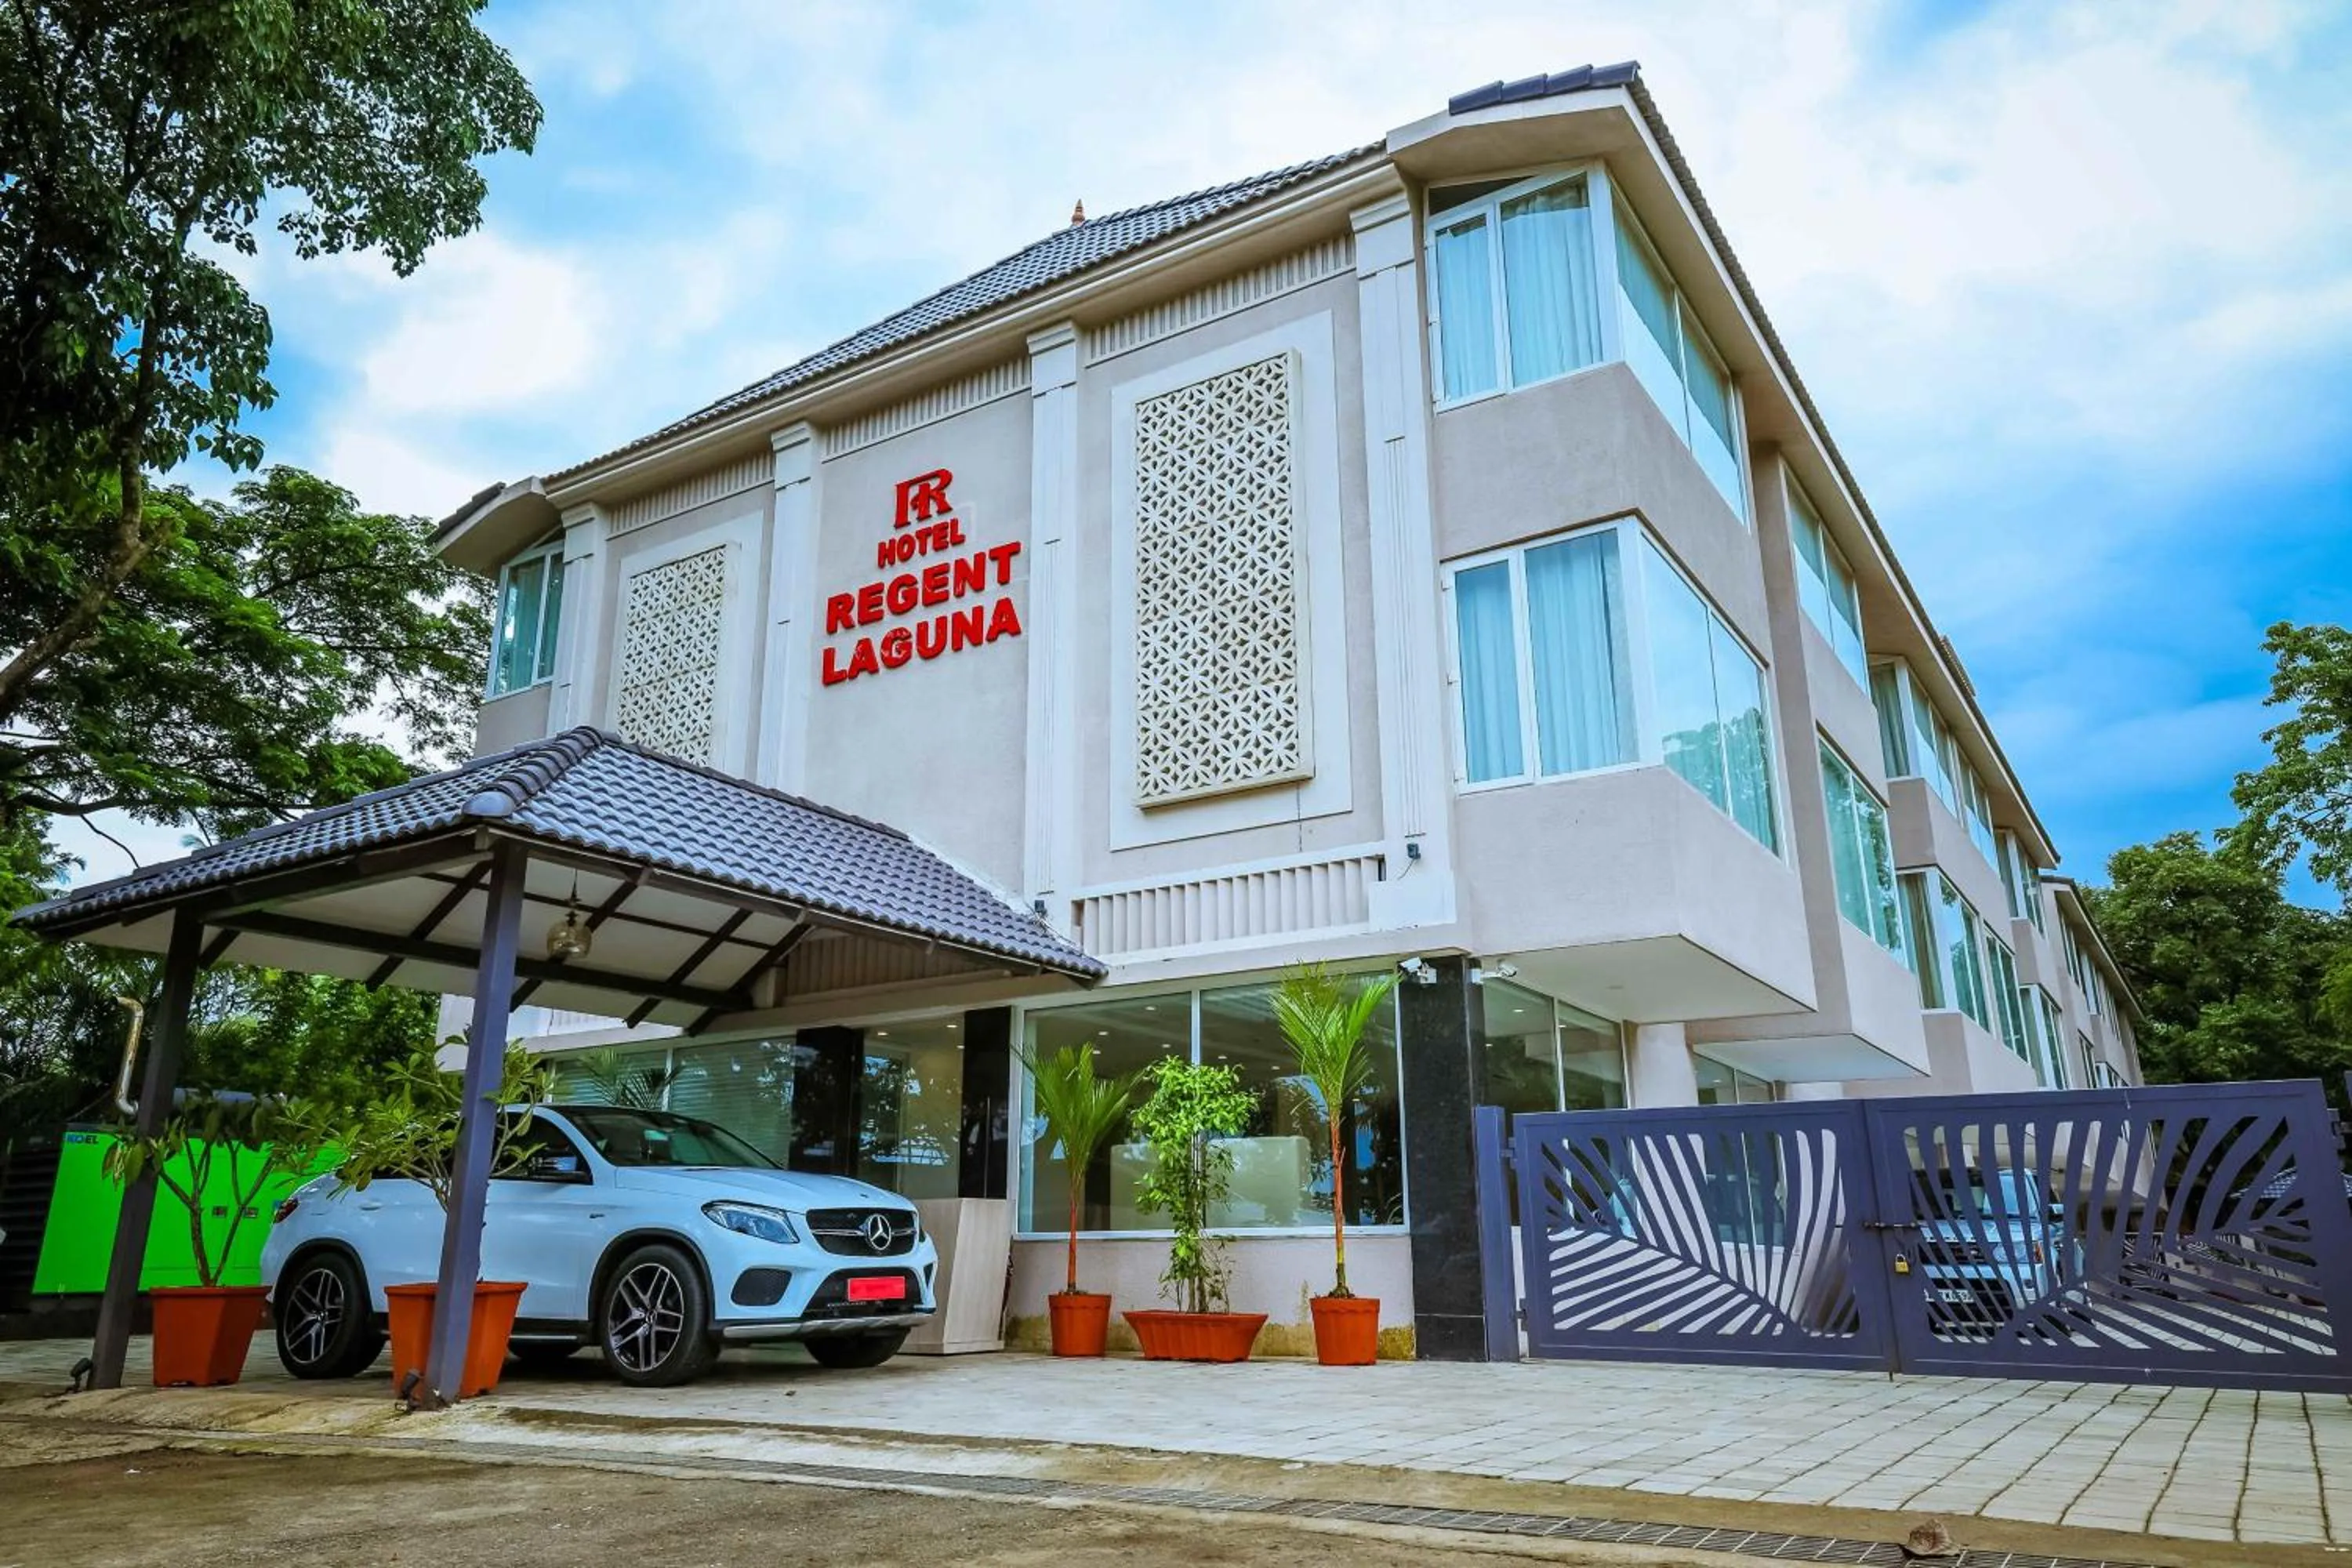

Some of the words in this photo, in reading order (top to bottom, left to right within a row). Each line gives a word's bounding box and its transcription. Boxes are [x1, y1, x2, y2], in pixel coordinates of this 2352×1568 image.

[826, 541, 1022, 633] REGENT
[877, 518, 966, 568] HOTEL
[822, 597, 1022, 686] LAGUNA
